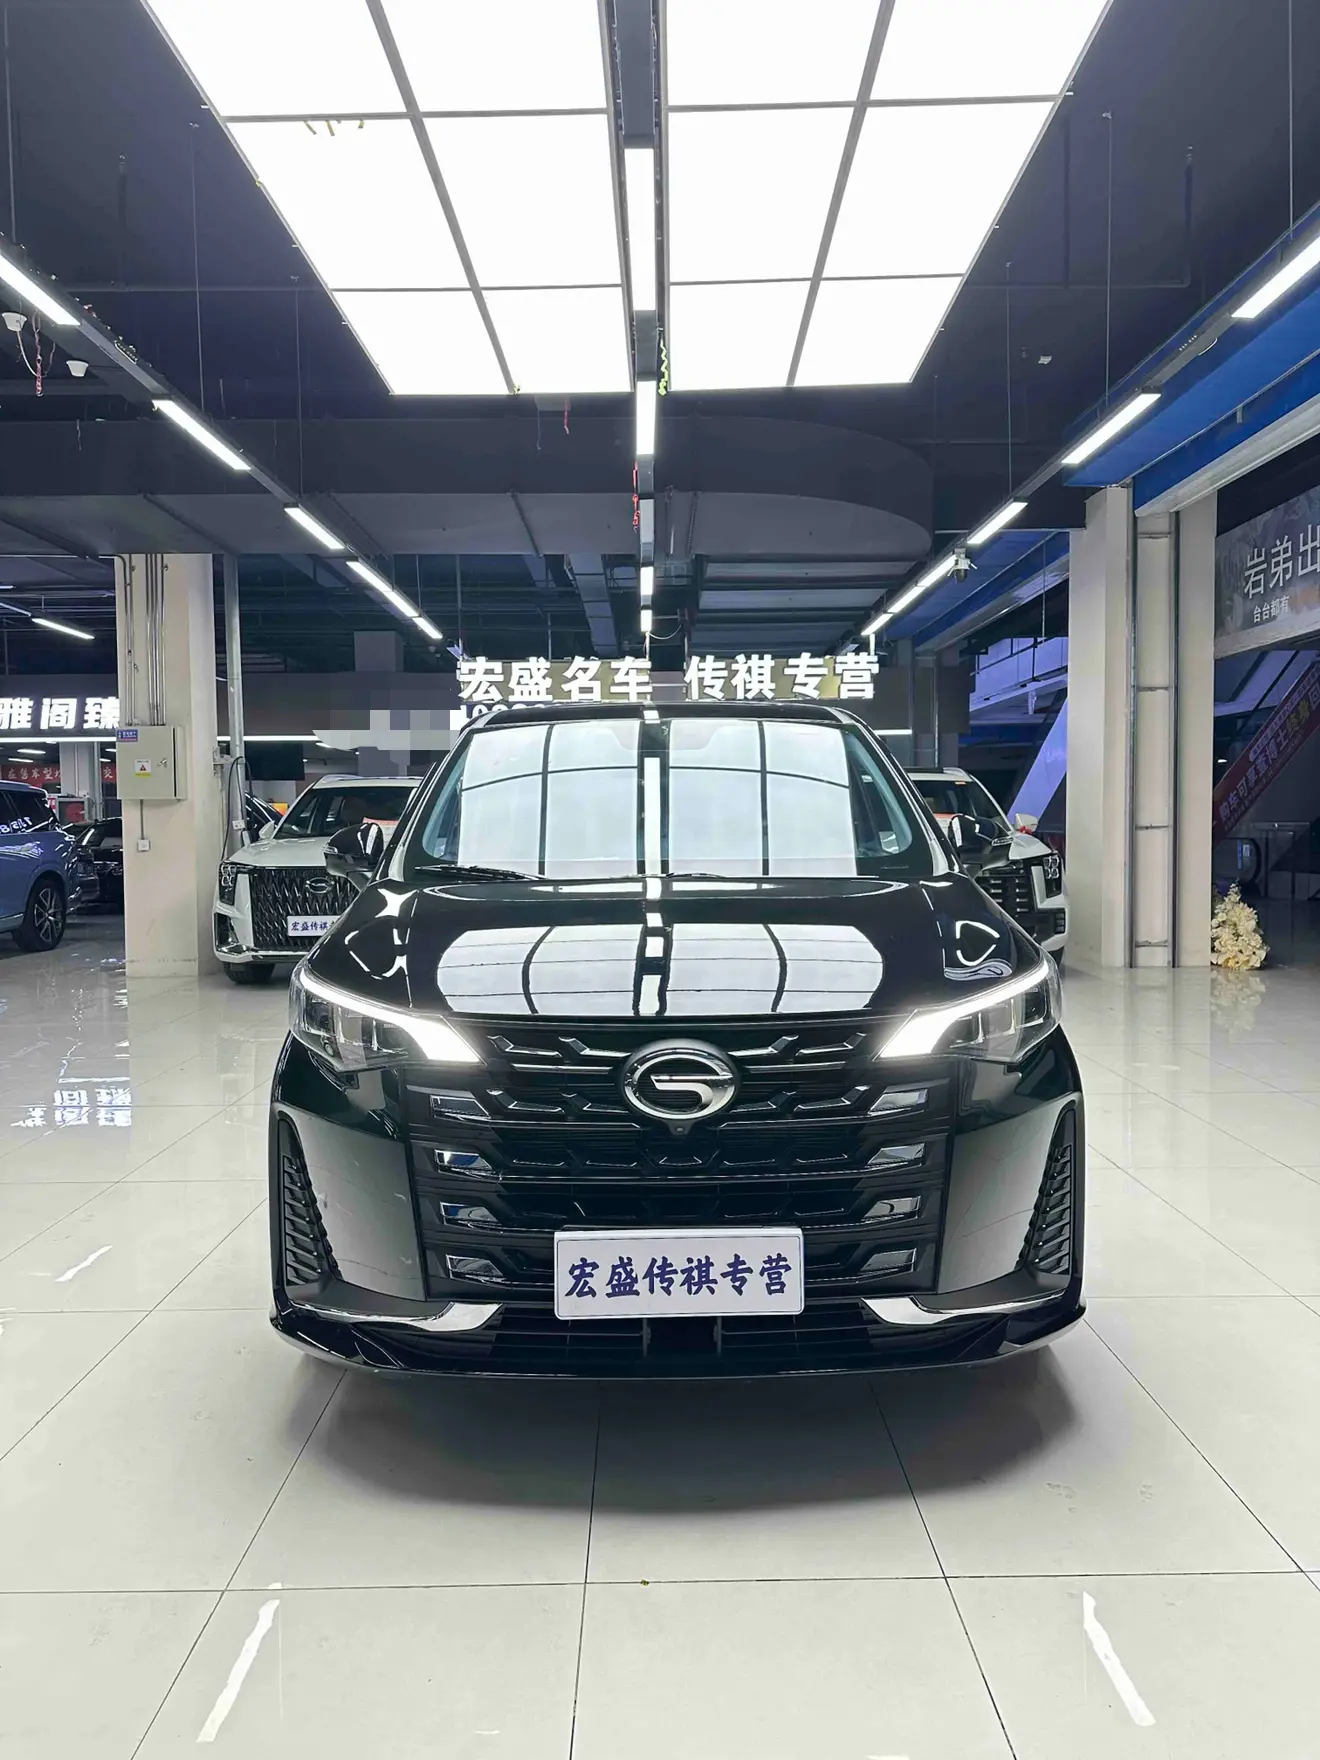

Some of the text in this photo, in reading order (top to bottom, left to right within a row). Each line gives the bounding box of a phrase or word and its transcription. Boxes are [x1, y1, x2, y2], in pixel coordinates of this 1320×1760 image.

[1253, 595, 1290, 623] 台台都有
[459, 652, 881, 703] 宏盛名车 传祺专营
[564, 1253, 792, 1299] 宏盛传祺专营
